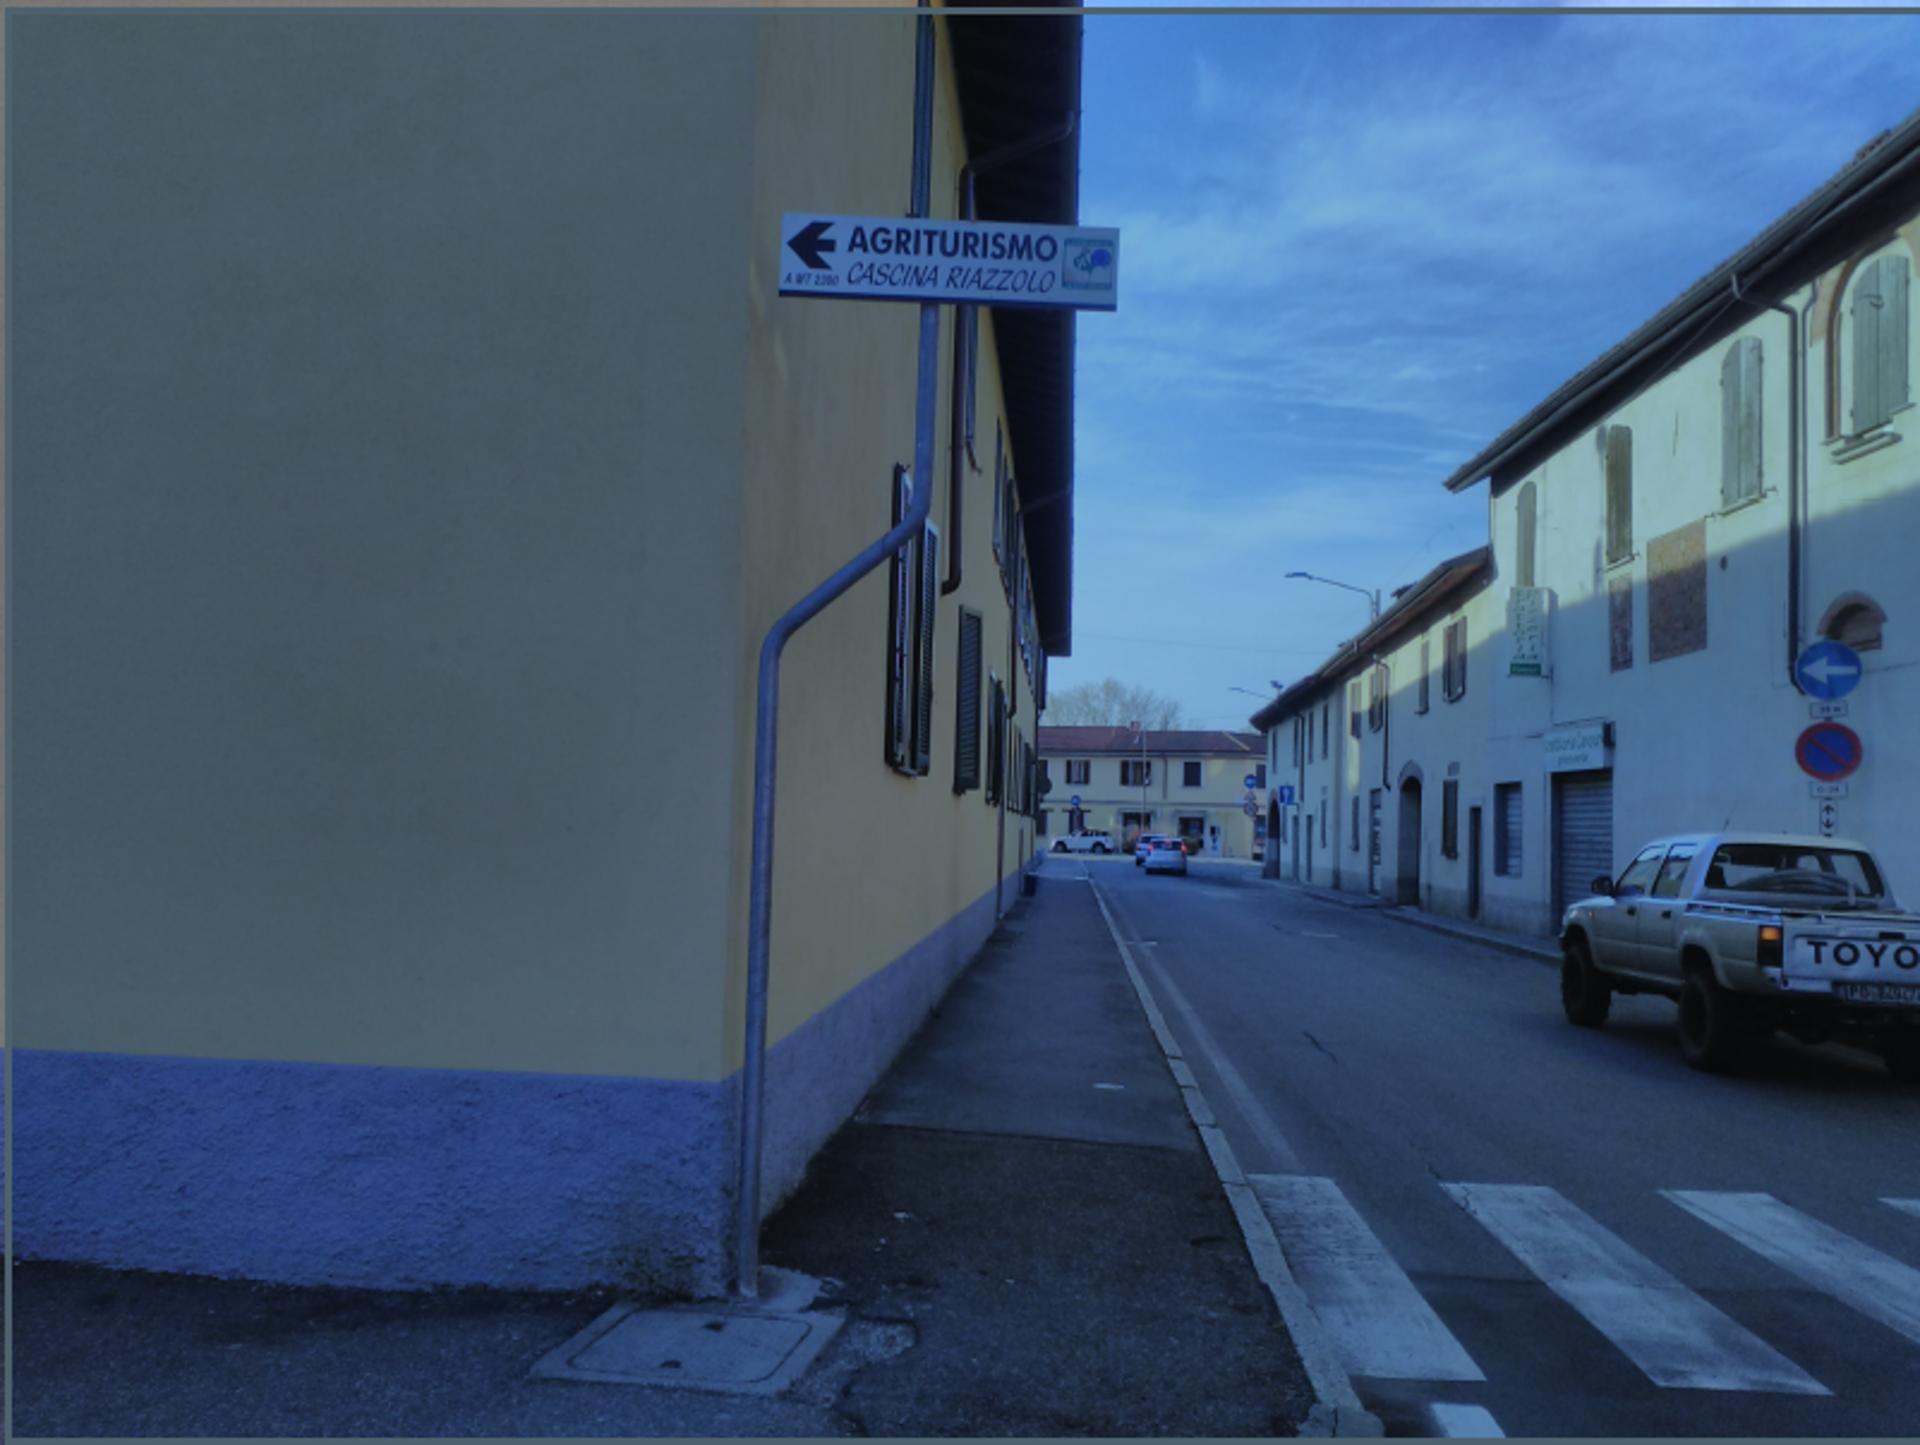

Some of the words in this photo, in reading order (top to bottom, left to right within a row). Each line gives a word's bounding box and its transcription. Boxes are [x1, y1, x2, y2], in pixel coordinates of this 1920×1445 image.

[847, 226, 1058, 262] AGRITURISMO
[846, 261, 939, 289] CASCINA
[946, 265, 1056, 293] RIAZZOLO
